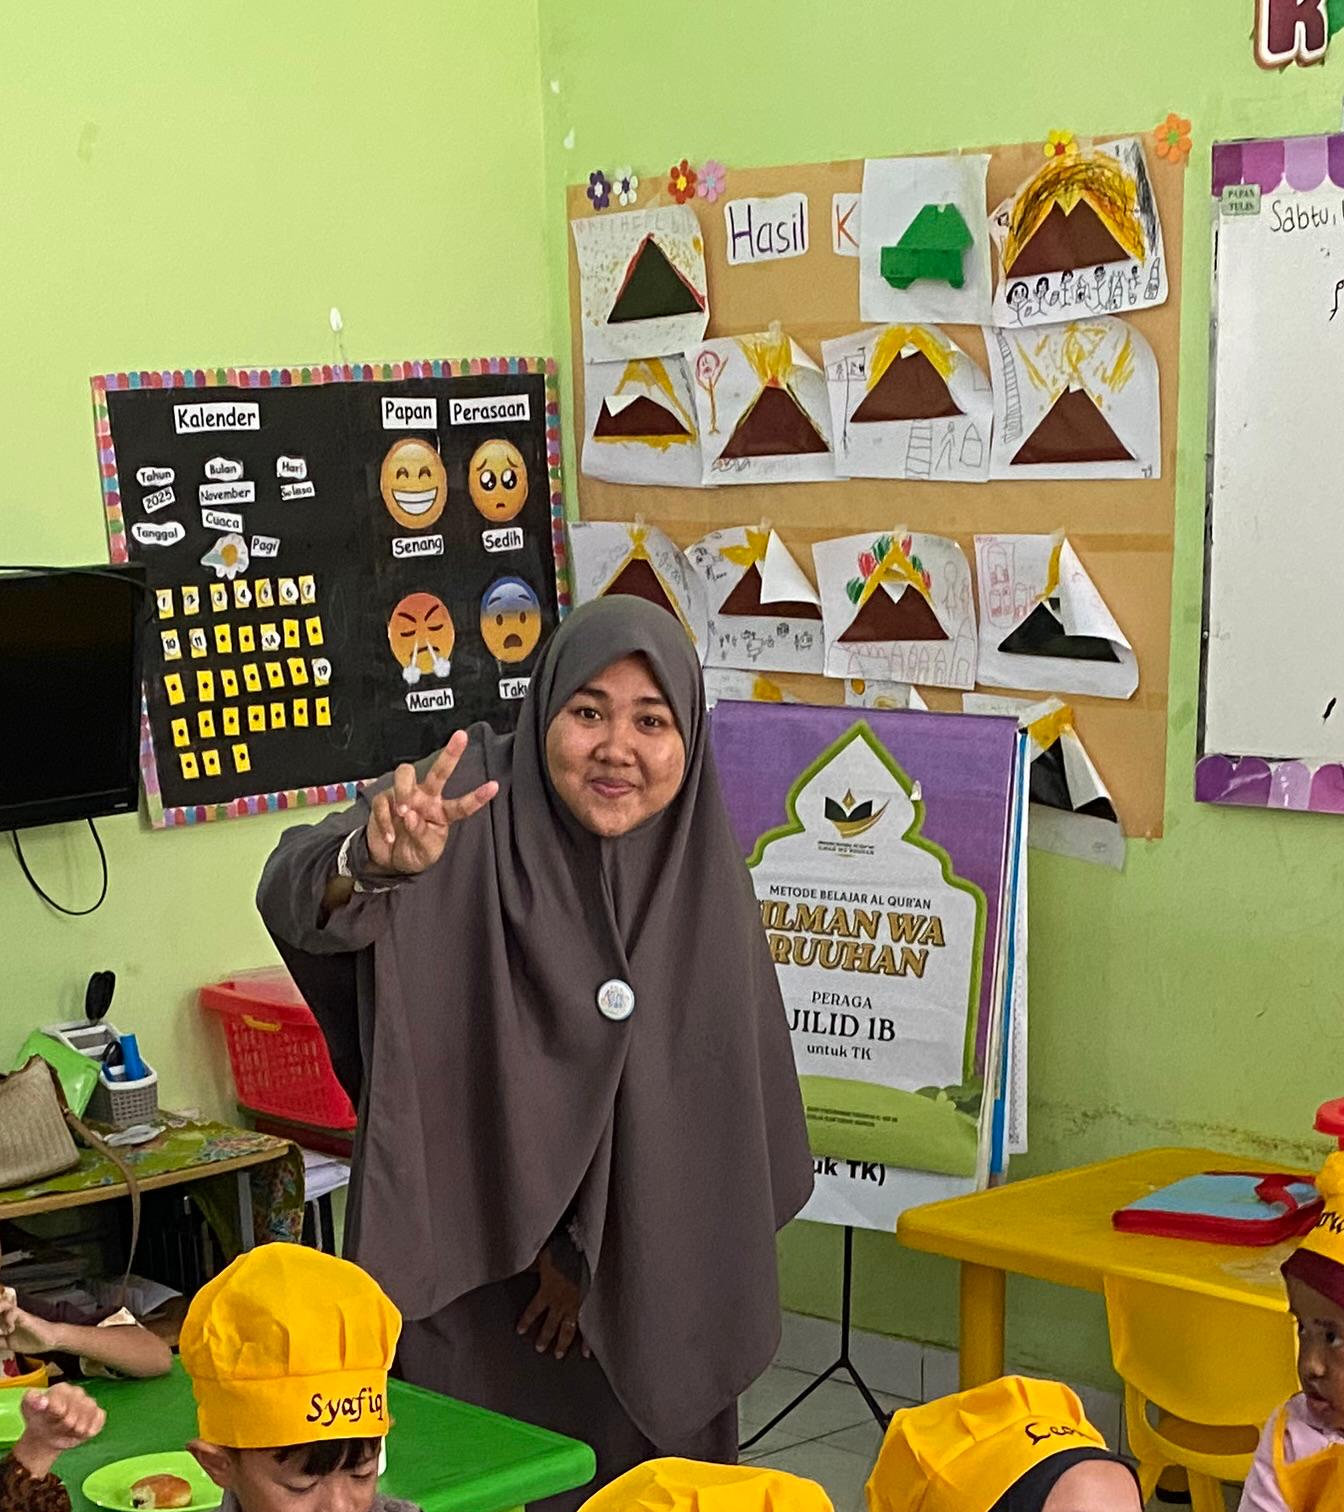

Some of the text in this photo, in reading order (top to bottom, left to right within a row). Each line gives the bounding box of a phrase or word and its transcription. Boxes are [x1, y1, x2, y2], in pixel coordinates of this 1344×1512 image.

[729, 201, 806, 260] Hasil
[178, 406, 256, 429] Kalender
[385, 401, 526, 424] Papan Perasaan
[140, 471, 171, 482] Tahun
[209, 462, 237, 474] Bulan
[282, 461, 304, 475] Hari
[145, 491, 173, 509] 2025
[201, 488, 251, 503] November
[205, 513, 240, 529] Cuaca
[136, 527, 178, 541] Tanggal
[485, 531, 521, 549] Sedih
[253, 538, 278, 556] Pagi
[394, 537, 442, 554] Senang
[217, 592, 223, 602] 3
[240, 589, 246, 599] 4
[166, 638, 176, 650] 10
[195, 637, 203, 646] 11
[318, 665, 328, 676] 19
[409, 692, 452, 710] Marah
[769, 885, 931, 910] METODE BELAJAR AL QUR'AN
[887, 912, 946, 946] WA
[769, 934, 929, 978] RUUHAN
[812, 991, 872, 1009] PERAGA
[789, 1008, 859, 1037] JILID
[807, 1045, 871, 1060] untuk TK
[846, 1159, 886, 1186] TK)
[306, 1387, 383, 1427] Syafiq
